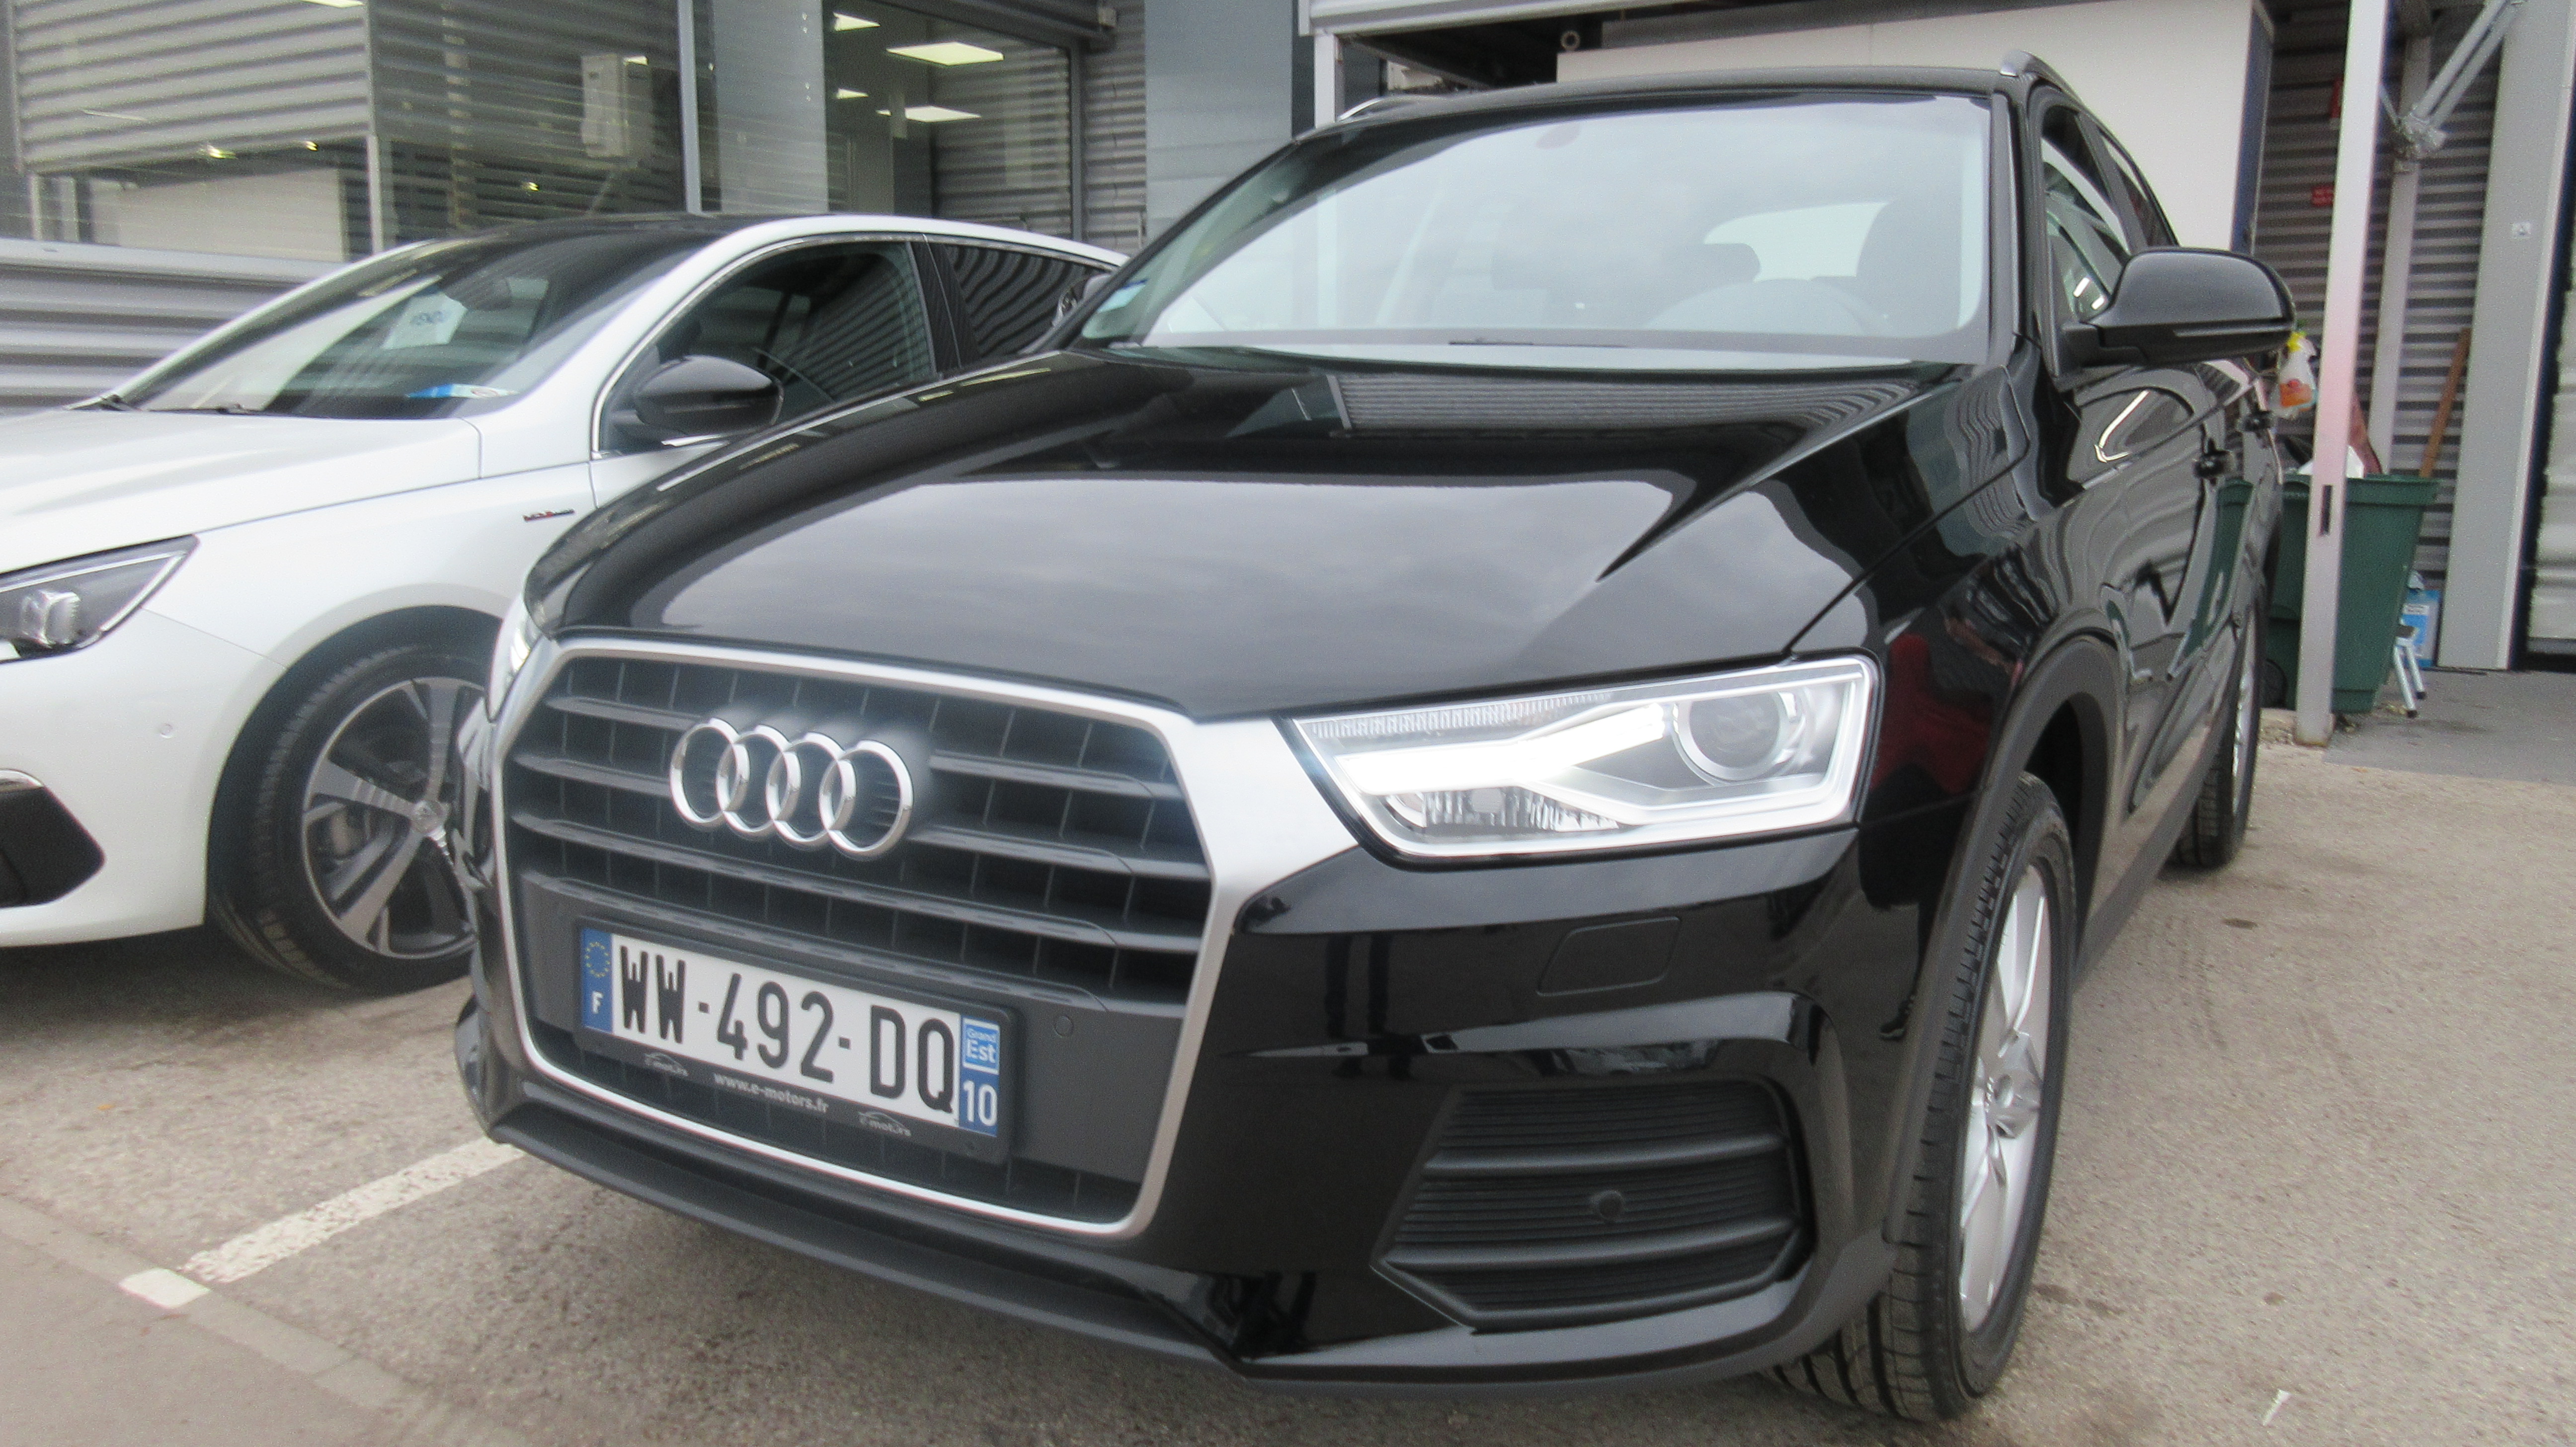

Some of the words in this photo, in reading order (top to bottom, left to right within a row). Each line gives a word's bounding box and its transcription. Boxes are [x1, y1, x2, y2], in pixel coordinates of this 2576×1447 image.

[592, 990, 603, 1014] F
[620, 946, 955, 1114] WW-492-DQ
[967, 1039, 996, 1064] Est
[713, 1072, 829, 1113] www.e-motors.fr
[963, 1080, 997, 1127] 10
